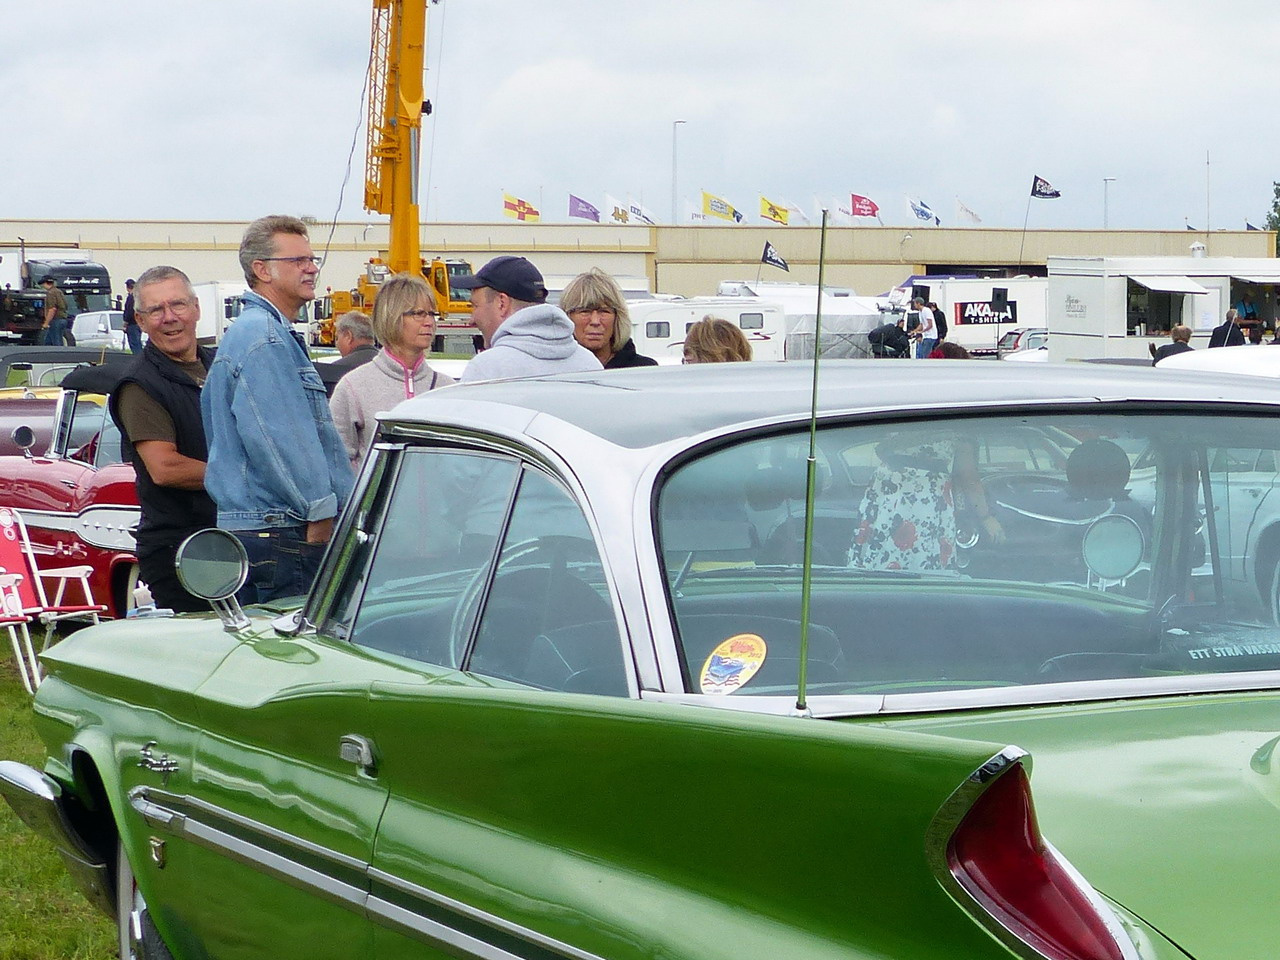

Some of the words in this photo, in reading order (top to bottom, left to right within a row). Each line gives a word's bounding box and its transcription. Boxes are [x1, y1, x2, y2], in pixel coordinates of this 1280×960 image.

[964, 302, 1013, 320] AKAA
[1188, 648, 1211, 660] ETT
[1211, 644, 1244, 658] STRÅ
